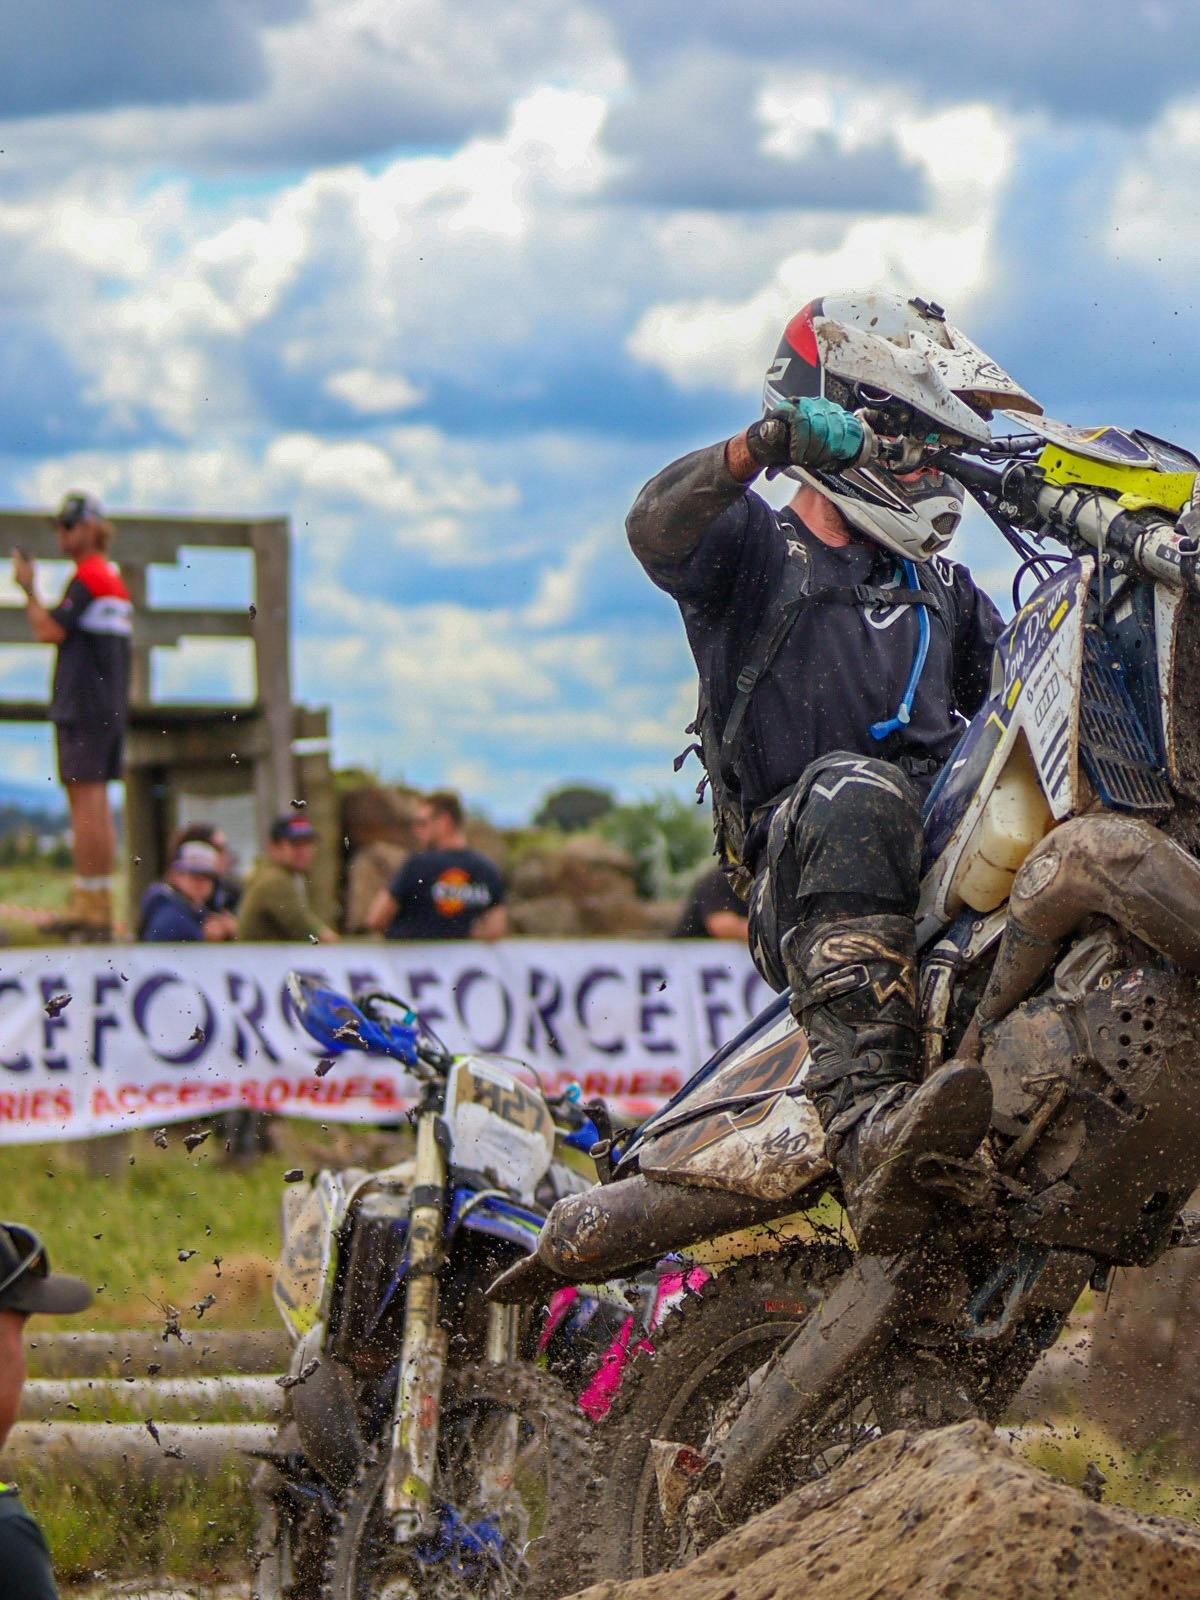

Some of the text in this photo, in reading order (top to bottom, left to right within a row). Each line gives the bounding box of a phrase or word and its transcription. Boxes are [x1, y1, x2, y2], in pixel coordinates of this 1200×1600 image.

[1001, 640, 1026, 706] Low
[407, 966, 679, 1057] FORCE
[92, 1076, 399, 1118] ACCESSORIES
